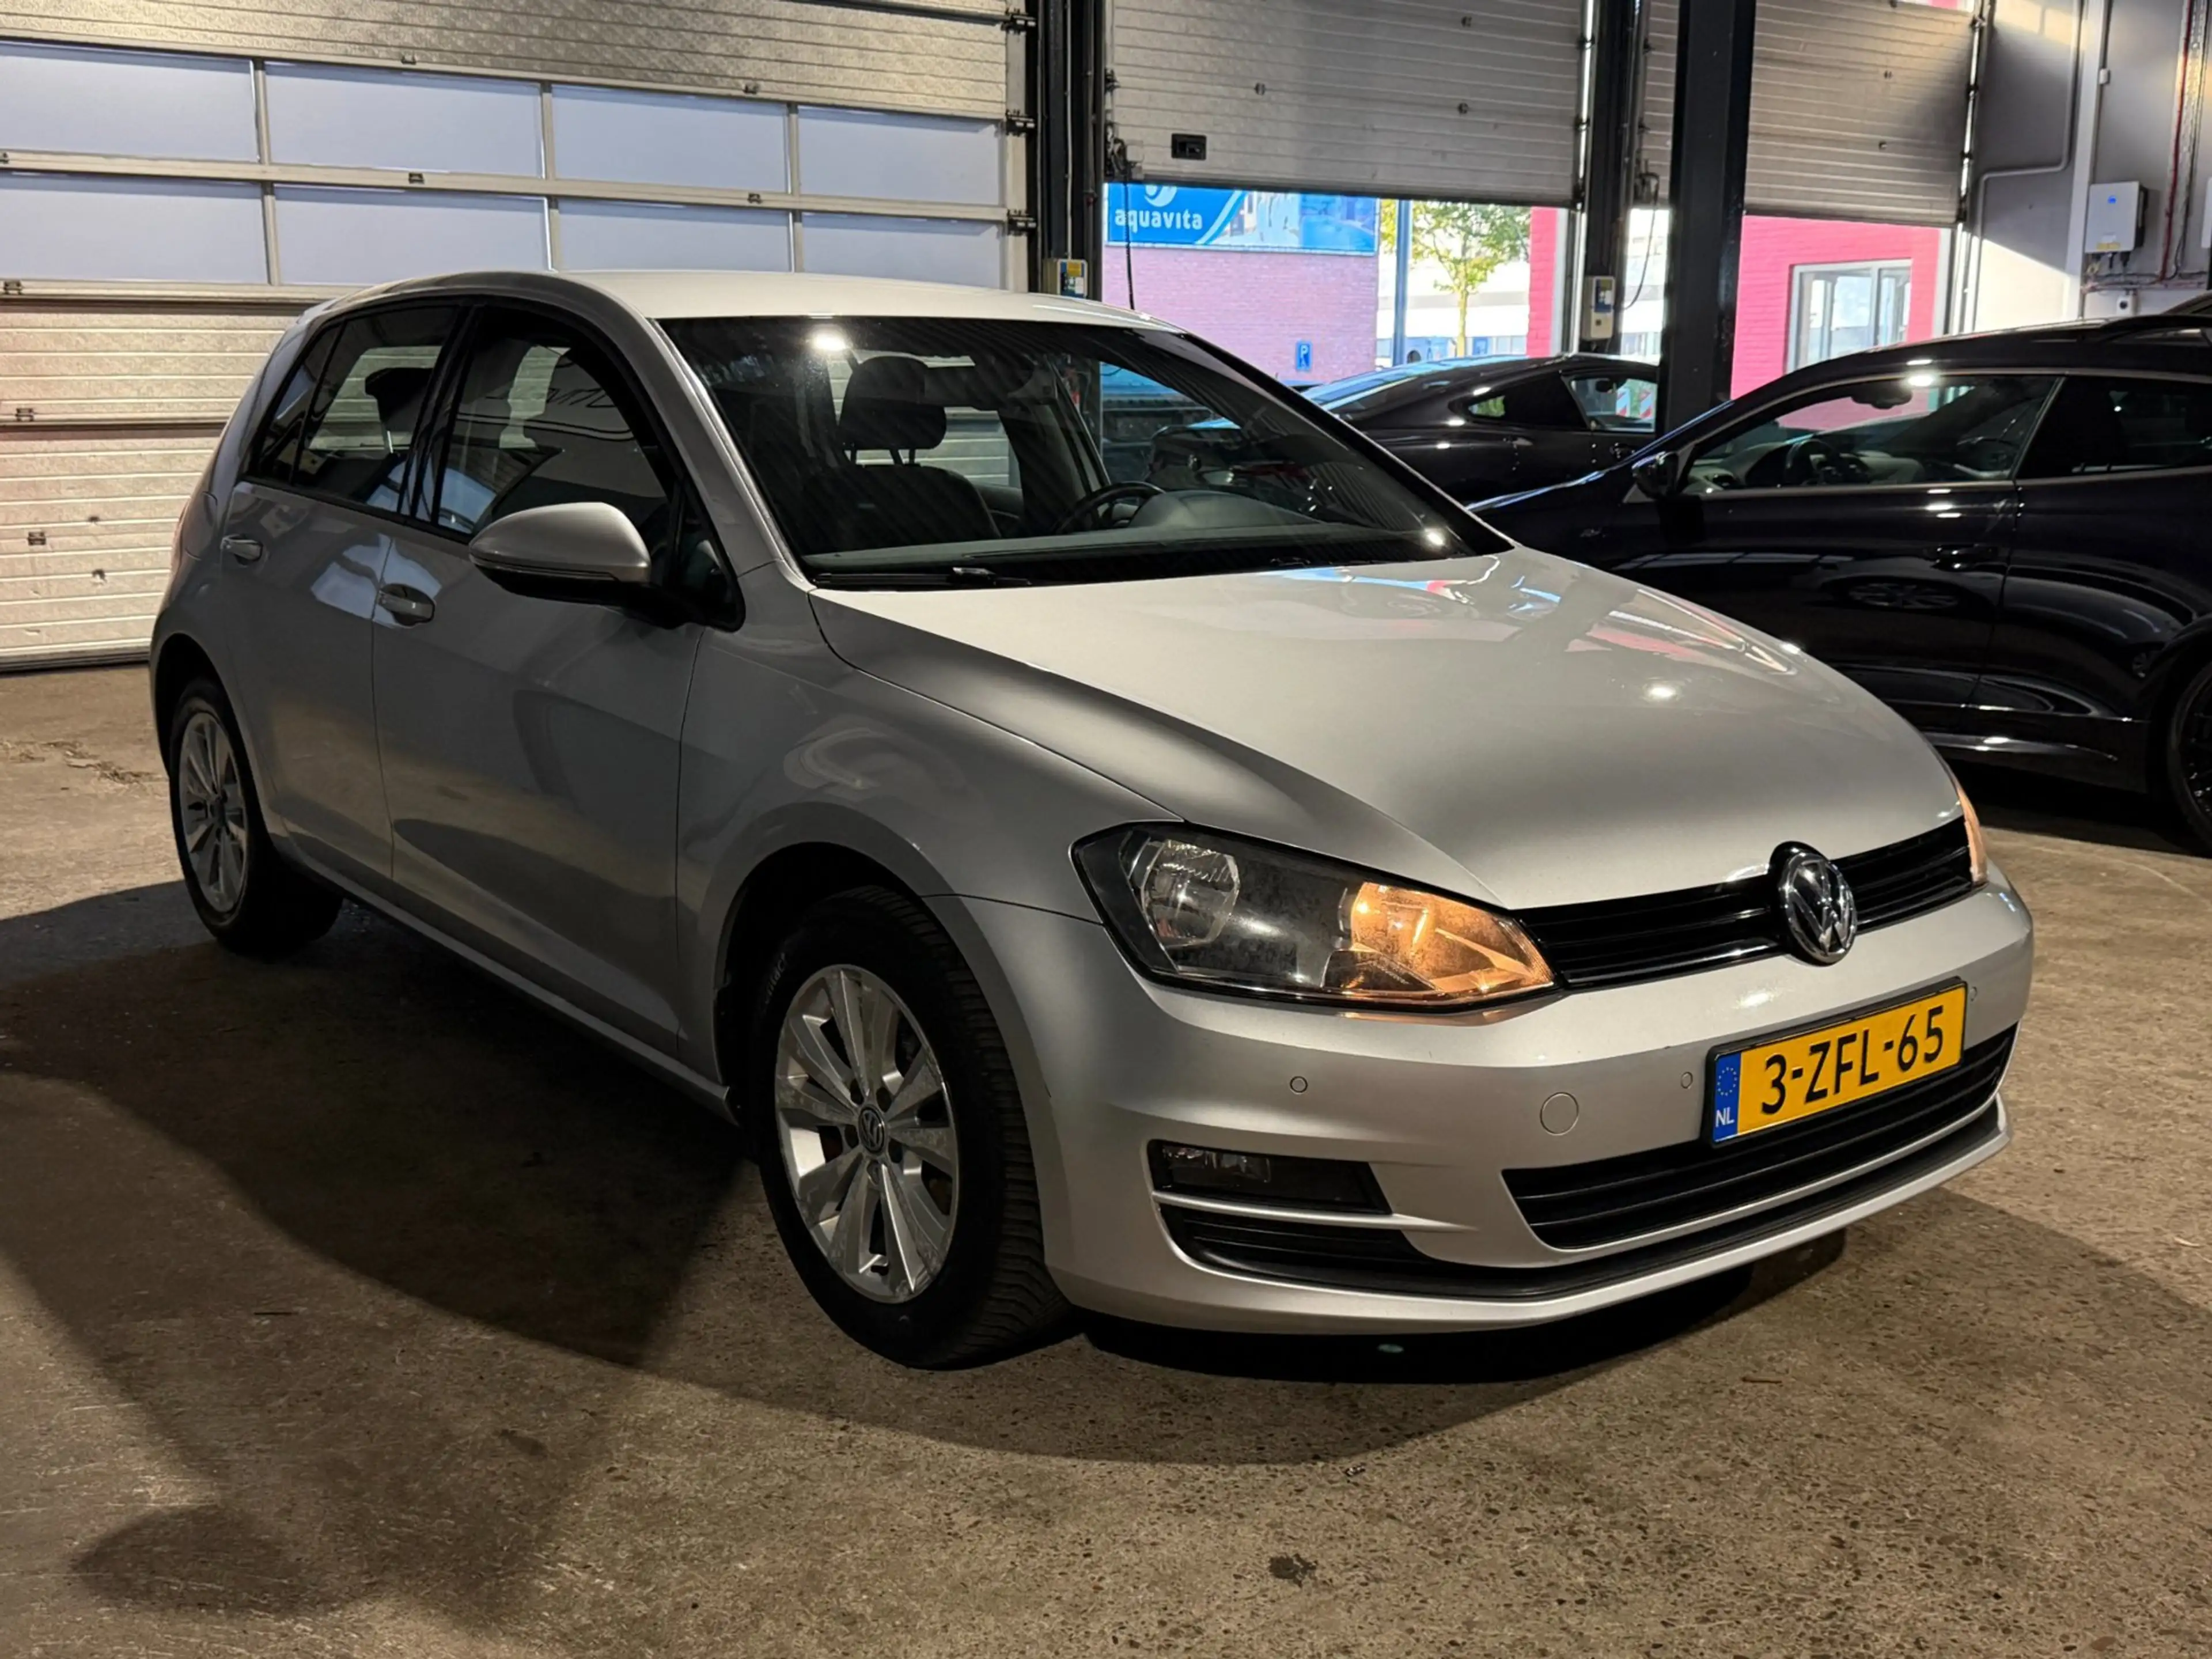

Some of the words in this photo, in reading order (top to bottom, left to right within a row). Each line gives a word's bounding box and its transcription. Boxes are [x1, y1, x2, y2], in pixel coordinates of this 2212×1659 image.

[1115, 209, 1203, 233] aquavita
[1301, 344, 1309, 358] P
[1761, 1005, 1944, 1115] 3-ZFL-65
[1715, 1106, 1735, 1128] NL
